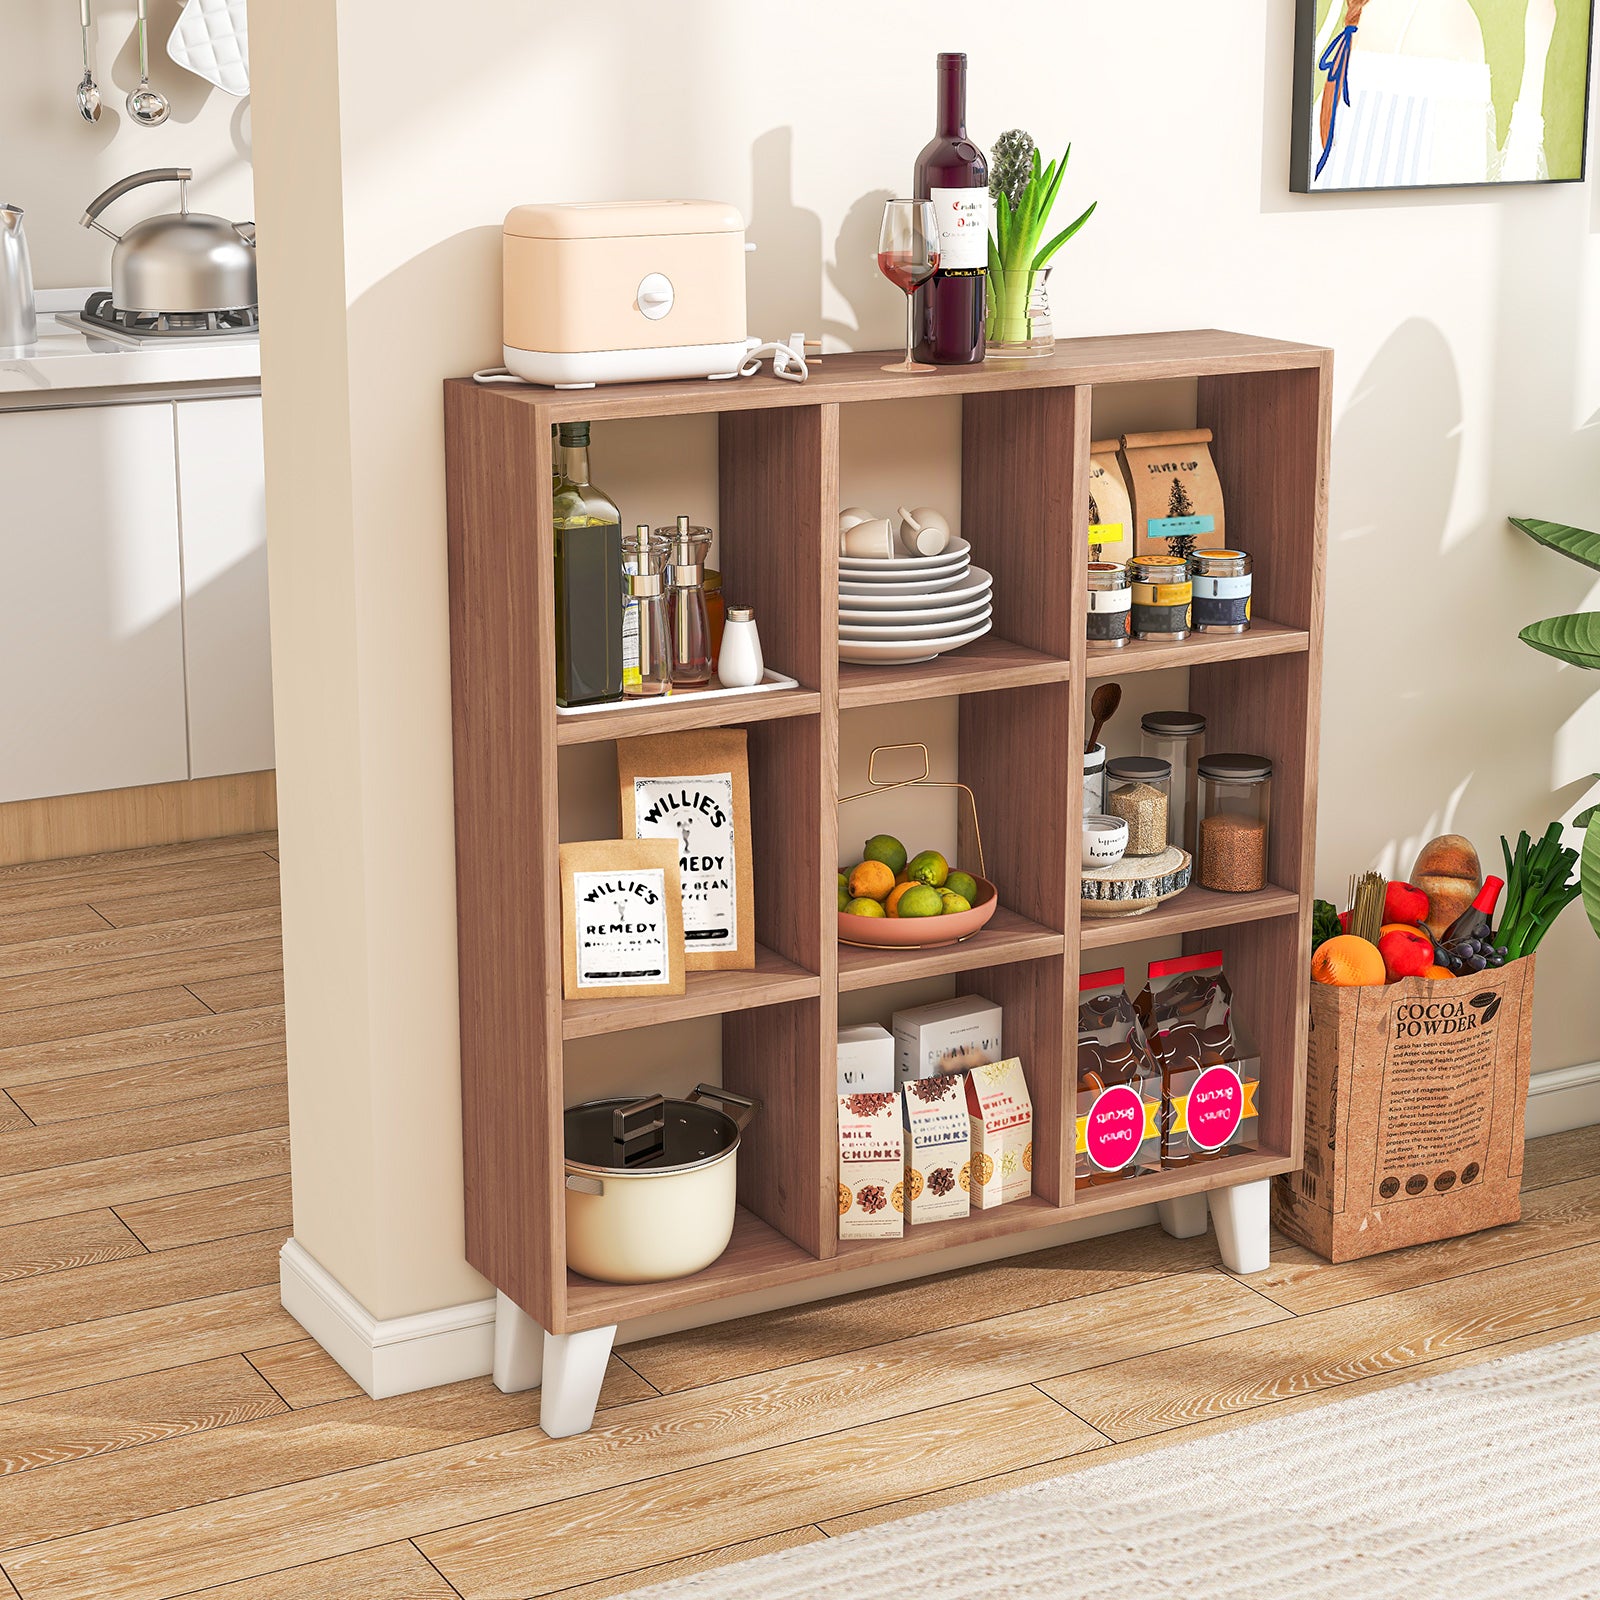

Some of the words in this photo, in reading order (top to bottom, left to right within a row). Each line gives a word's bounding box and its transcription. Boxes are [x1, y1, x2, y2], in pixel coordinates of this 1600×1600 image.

[1148, 463, 1178, 474] SILVER
[1180, 461, 1199, 472] CUP
[644, 789, 726, 828] WILLIE'S
[583, 880, 659, 905] WILLIE'S
[586, 923, 657, 935] REMEDY
[1396, 1002, 1465, 1021] COCOA
[1395, 1013, 1478, 1039] POWDER
[982, 1096, 1013, 1110] WHITE
[985, 1111, 1031, 1130] CHUNKS
[842, 1131, 872, 1139] MILK
[914, 1131, 968, 1145] CHUNKS
[841, 1149, 901, 1160] CHUNKS
